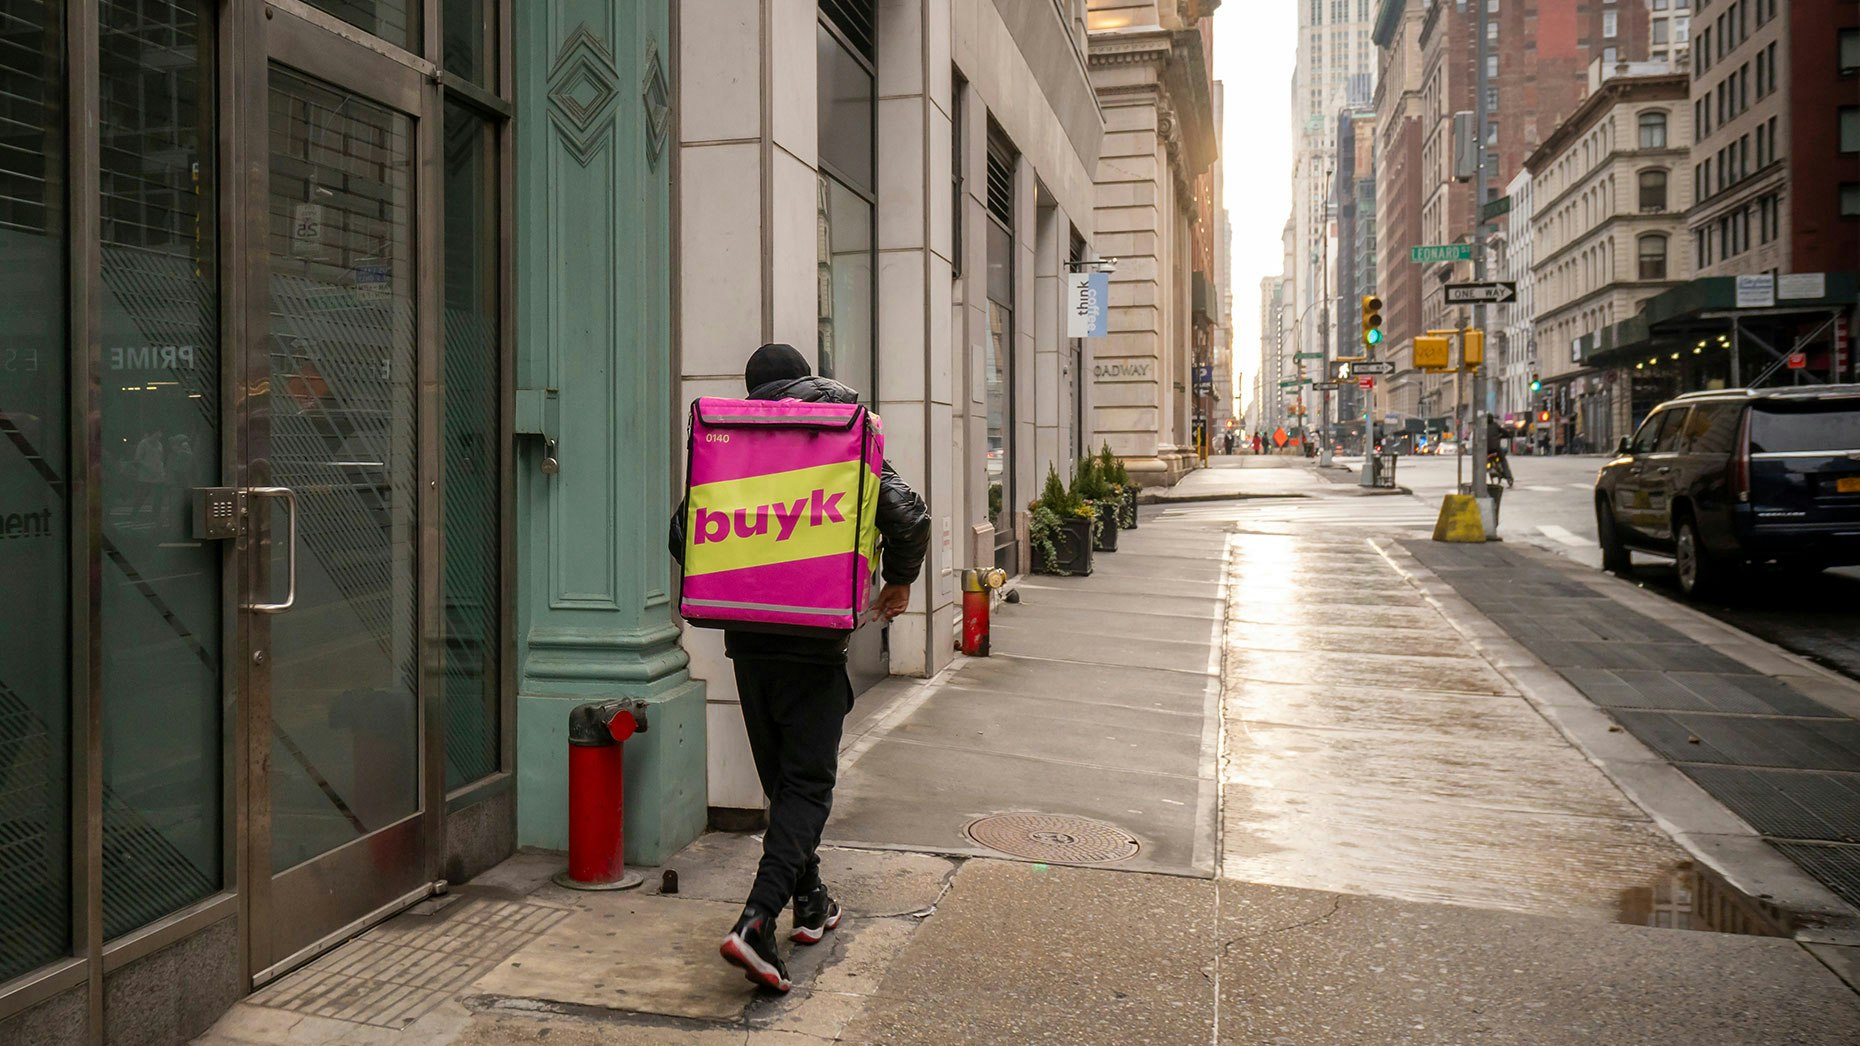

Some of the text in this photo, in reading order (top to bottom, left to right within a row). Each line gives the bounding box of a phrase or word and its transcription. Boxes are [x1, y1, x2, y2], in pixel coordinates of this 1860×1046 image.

[1411, 247, 1460, 261] LEONARD
[1077, 281, 1089, 316] think
[1454, 288, 1506, 299] ONE WAY
[1088, 288, 1099, 331] coffee
[706, 433, 730, 444] 0140
[0, 508, 52, 539] ent
[694, 489, 847, 545] buyk
